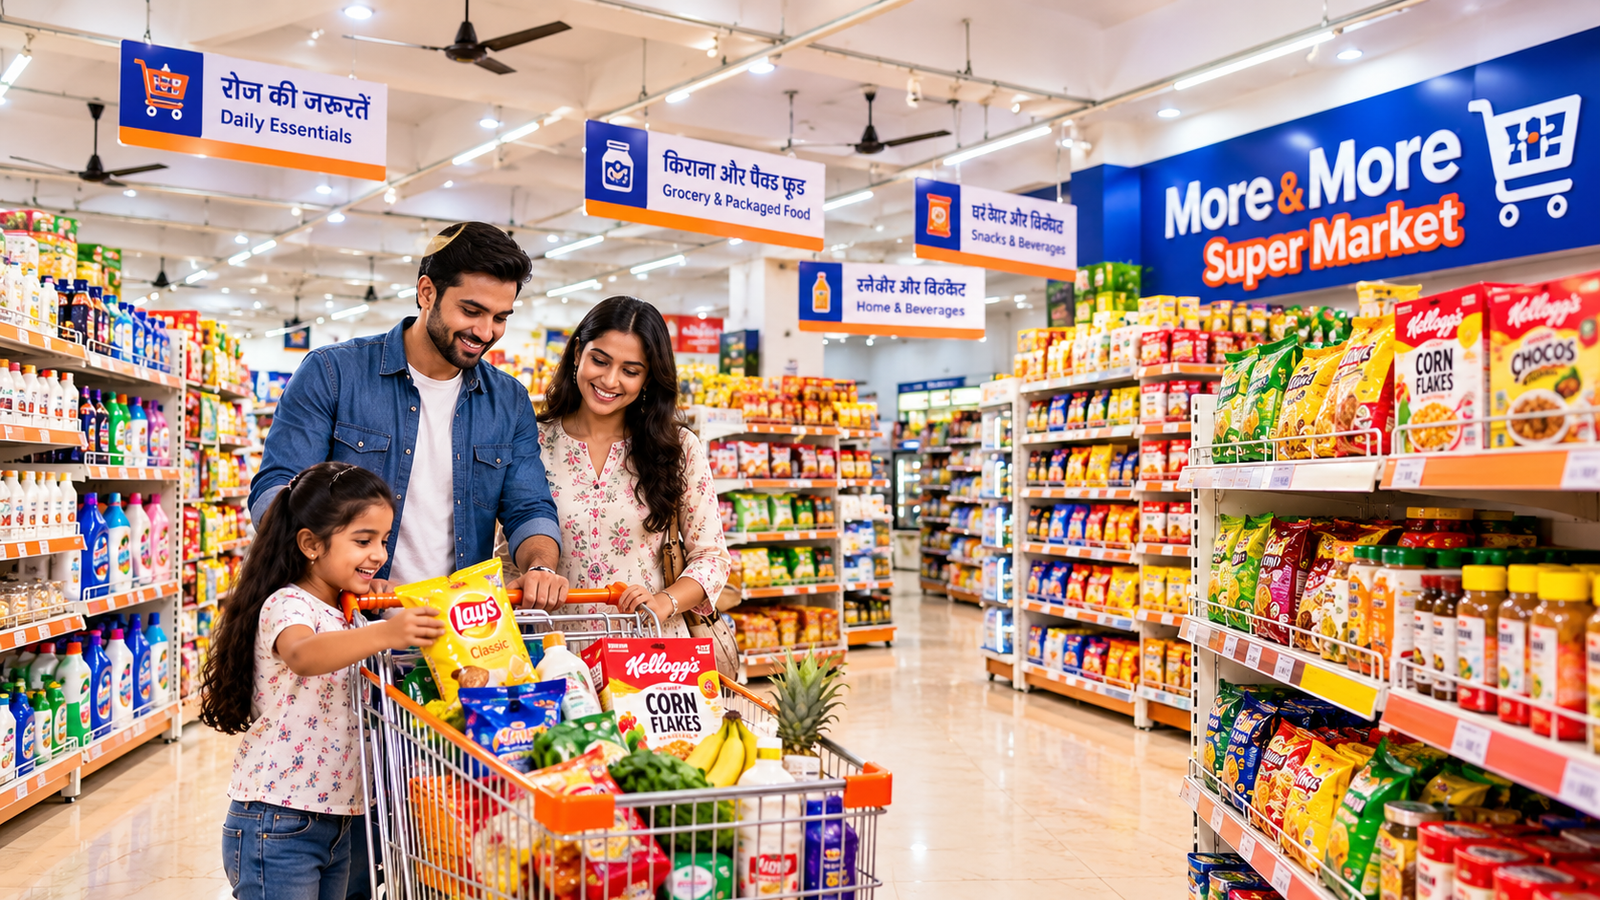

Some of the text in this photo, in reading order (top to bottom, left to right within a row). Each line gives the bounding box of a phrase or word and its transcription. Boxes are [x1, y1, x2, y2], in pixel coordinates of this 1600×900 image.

[220, 71, 371, 120] रोज की जरूरतें
[221, 109, 352, 144] Daily Essentials
[662, 150, 716, 180] किराना
[720, 160, 746, 185] और
[781, 175, 806, 201] फूड
[1164, 128, 1462, 239] More & More
[662, 183, 811, 221] Grocery & Packaged Food
[971, 229, 1066, 257] Snacks & Beverages
[1205, 199, 1460, 287] Super Market
[856, 301, 965, 319] Home & Beverages
[1407, 307, 1464, 339] Kellogg's
[1507, 292, 1582, 329] Kellogg's
[1416, 348, 1454, 375] CORN
[1416, 373, 1454, 395] FLAKES
[470, 640, 510, 659] Classic
[625, 652, 700, 682] Kellogg's
[646, 692, 698, 715] CORN
[650, 715, 702, 733] FLAKES
